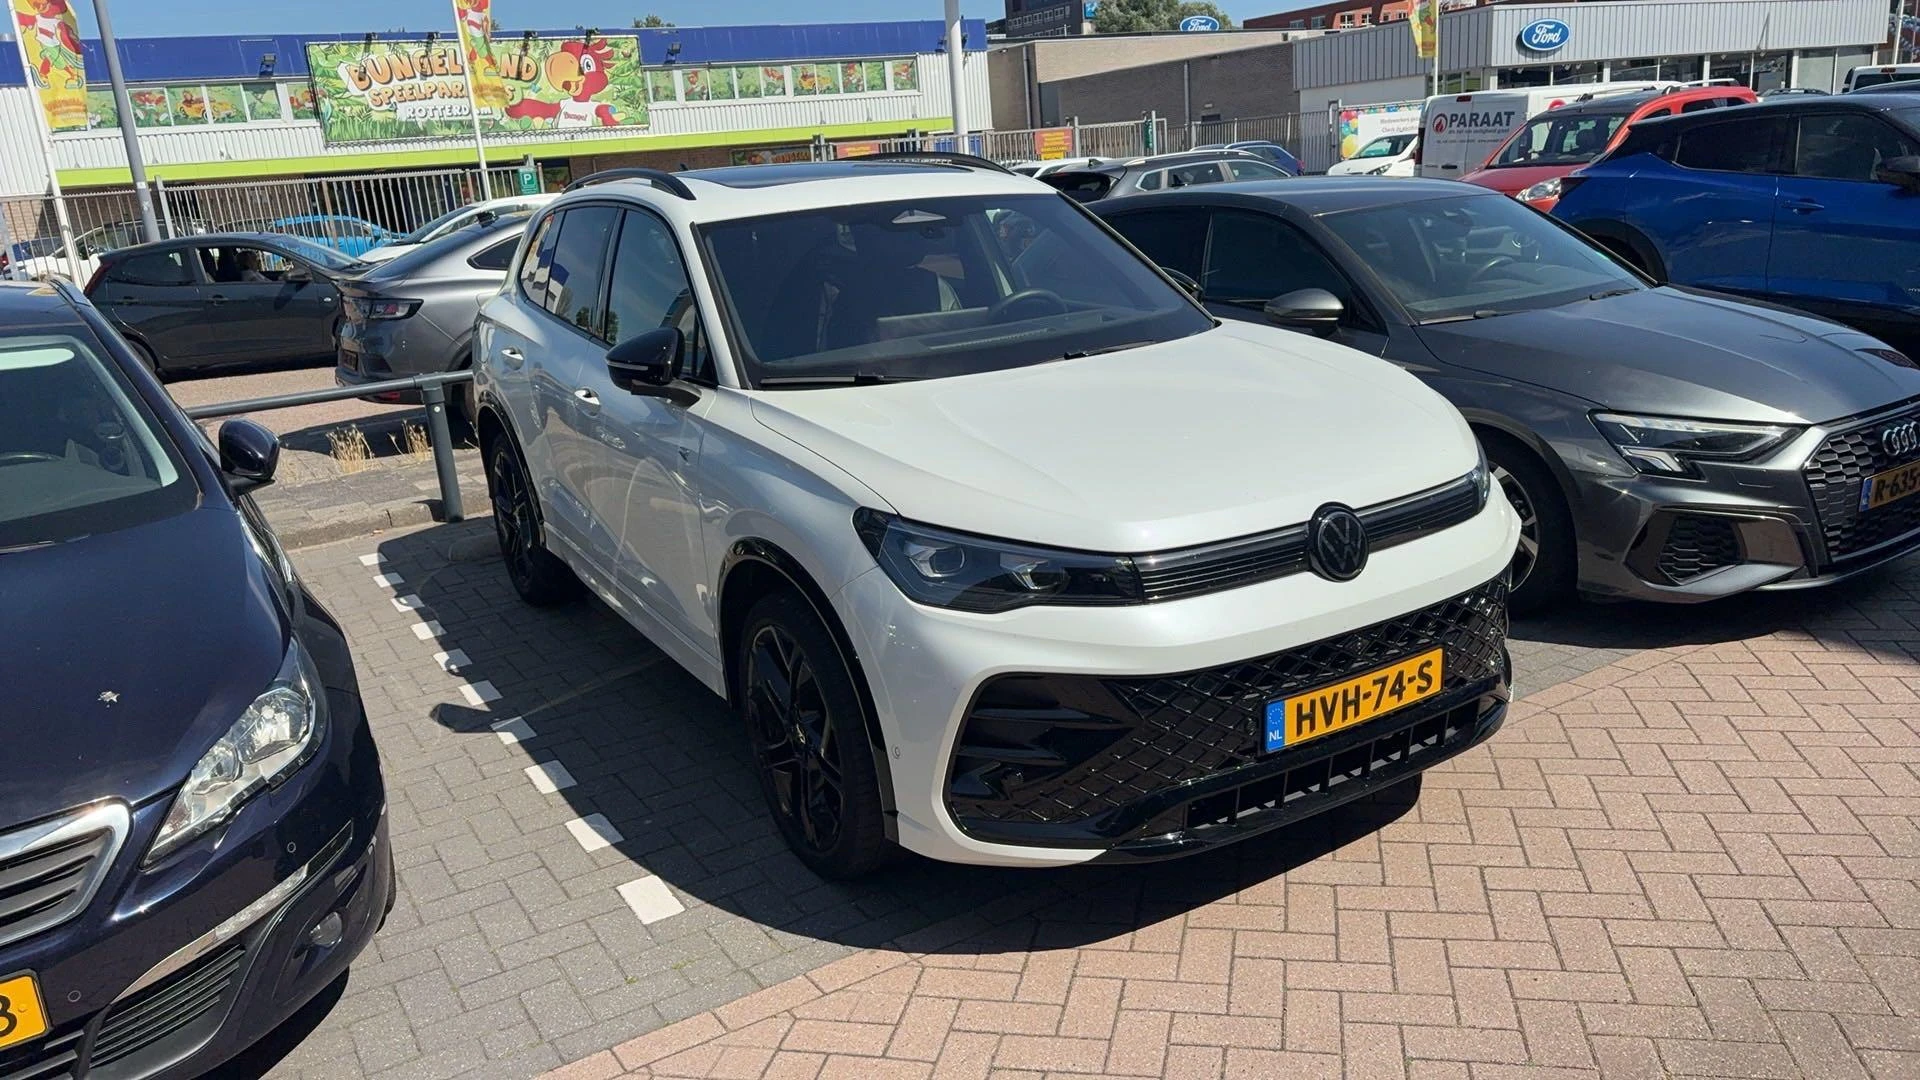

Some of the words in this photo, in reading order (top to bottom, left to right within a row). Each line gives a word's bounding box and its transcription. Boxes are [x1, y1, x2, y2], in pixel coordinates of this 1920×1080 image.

[1187, 19, 1212, 31] Ford
[1532, 23, 1562, 44] Ford
[346, 47, 538, 91] BUNGELND
[405, 104, 493, 120] ROTTERDM
[1448, 111, 1515, 128] PARAAT
[523, 173, 532, 185] P
[1296, 660, 1433, 737] HVH-74-S
[1269, 729, 1283, 742] NL
